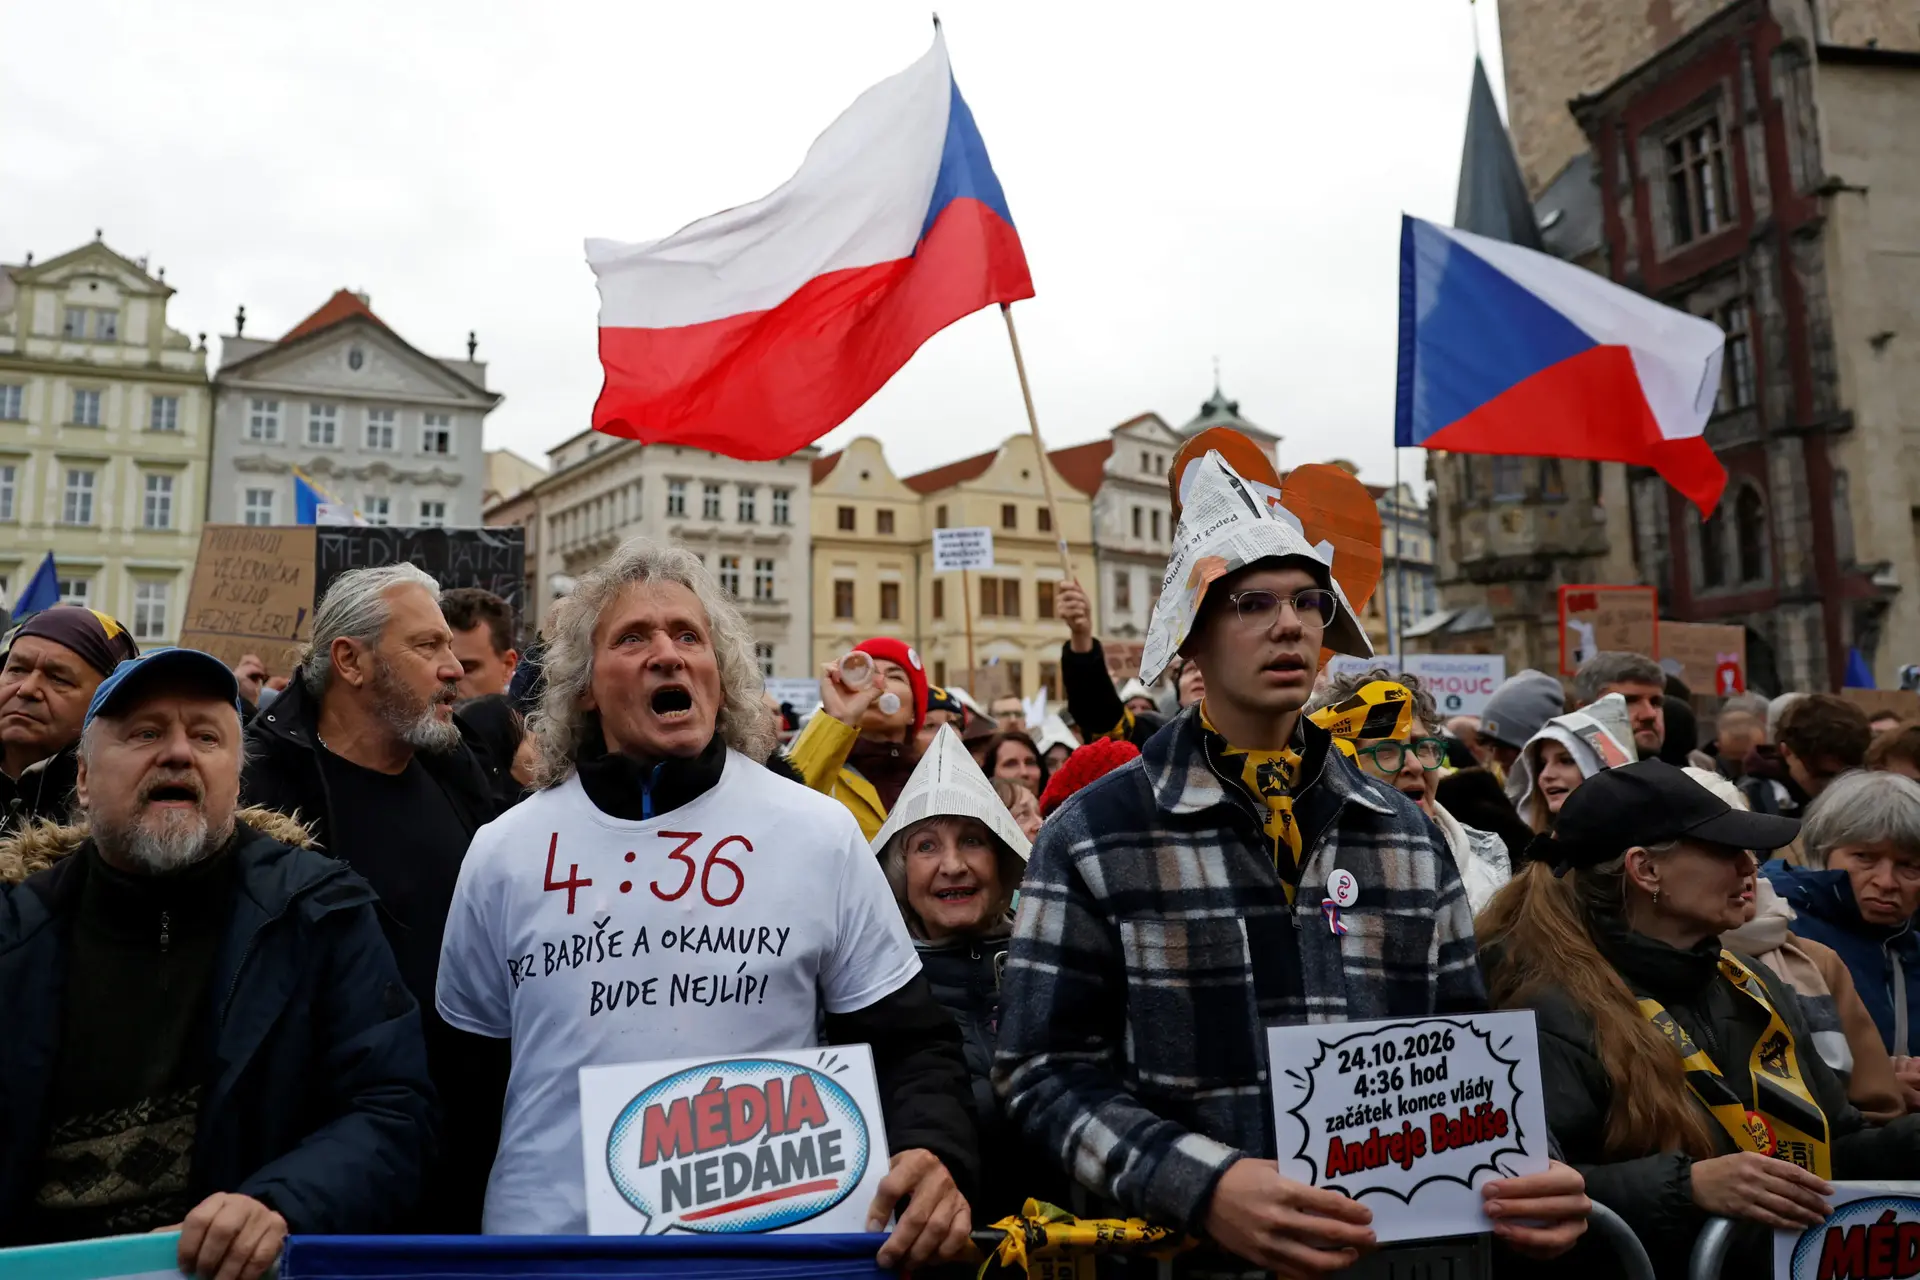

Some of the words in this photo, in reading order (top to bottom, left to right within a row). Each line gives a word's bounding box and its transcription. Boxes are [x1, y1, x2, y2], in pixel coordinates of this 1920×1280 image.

[1191, 532, 1204, 545] je
[1161, 553, 1185, 592] nemoc
[1421, 674, 1494, 695] MOUC
[507, 953, 537, 989] BEZ
[543, 916, 624, 976] BABIŠE
[632, 926, 650, 957] A
[661, 925, 790, 956] OKAMURY
[590, 977, 658, 1016] BUDE
[670, 961, 768, 1007] NEJLÍP!
[1338, 1028, 1455, 1074] 24.10.2026
[1354, 1066, 1404, 1098] 4:36
[1410, 1056, 1448, 1087] hod
[638, 1072, 829, 1169] MÉDIA
[1326, 1100, 1393, 1133] začátek
[1398, 1089, 1446, 1116] konce
[1450, 1076, 1494, 1104] vlády
[1325, 1120, 1427, 1179] Andreje
[1429, 1100, 1509, 1154] Babiše
[661, 1128, 845, 1214] NEDÁME
[1816, 1209, 1920, 1280] MÉD
